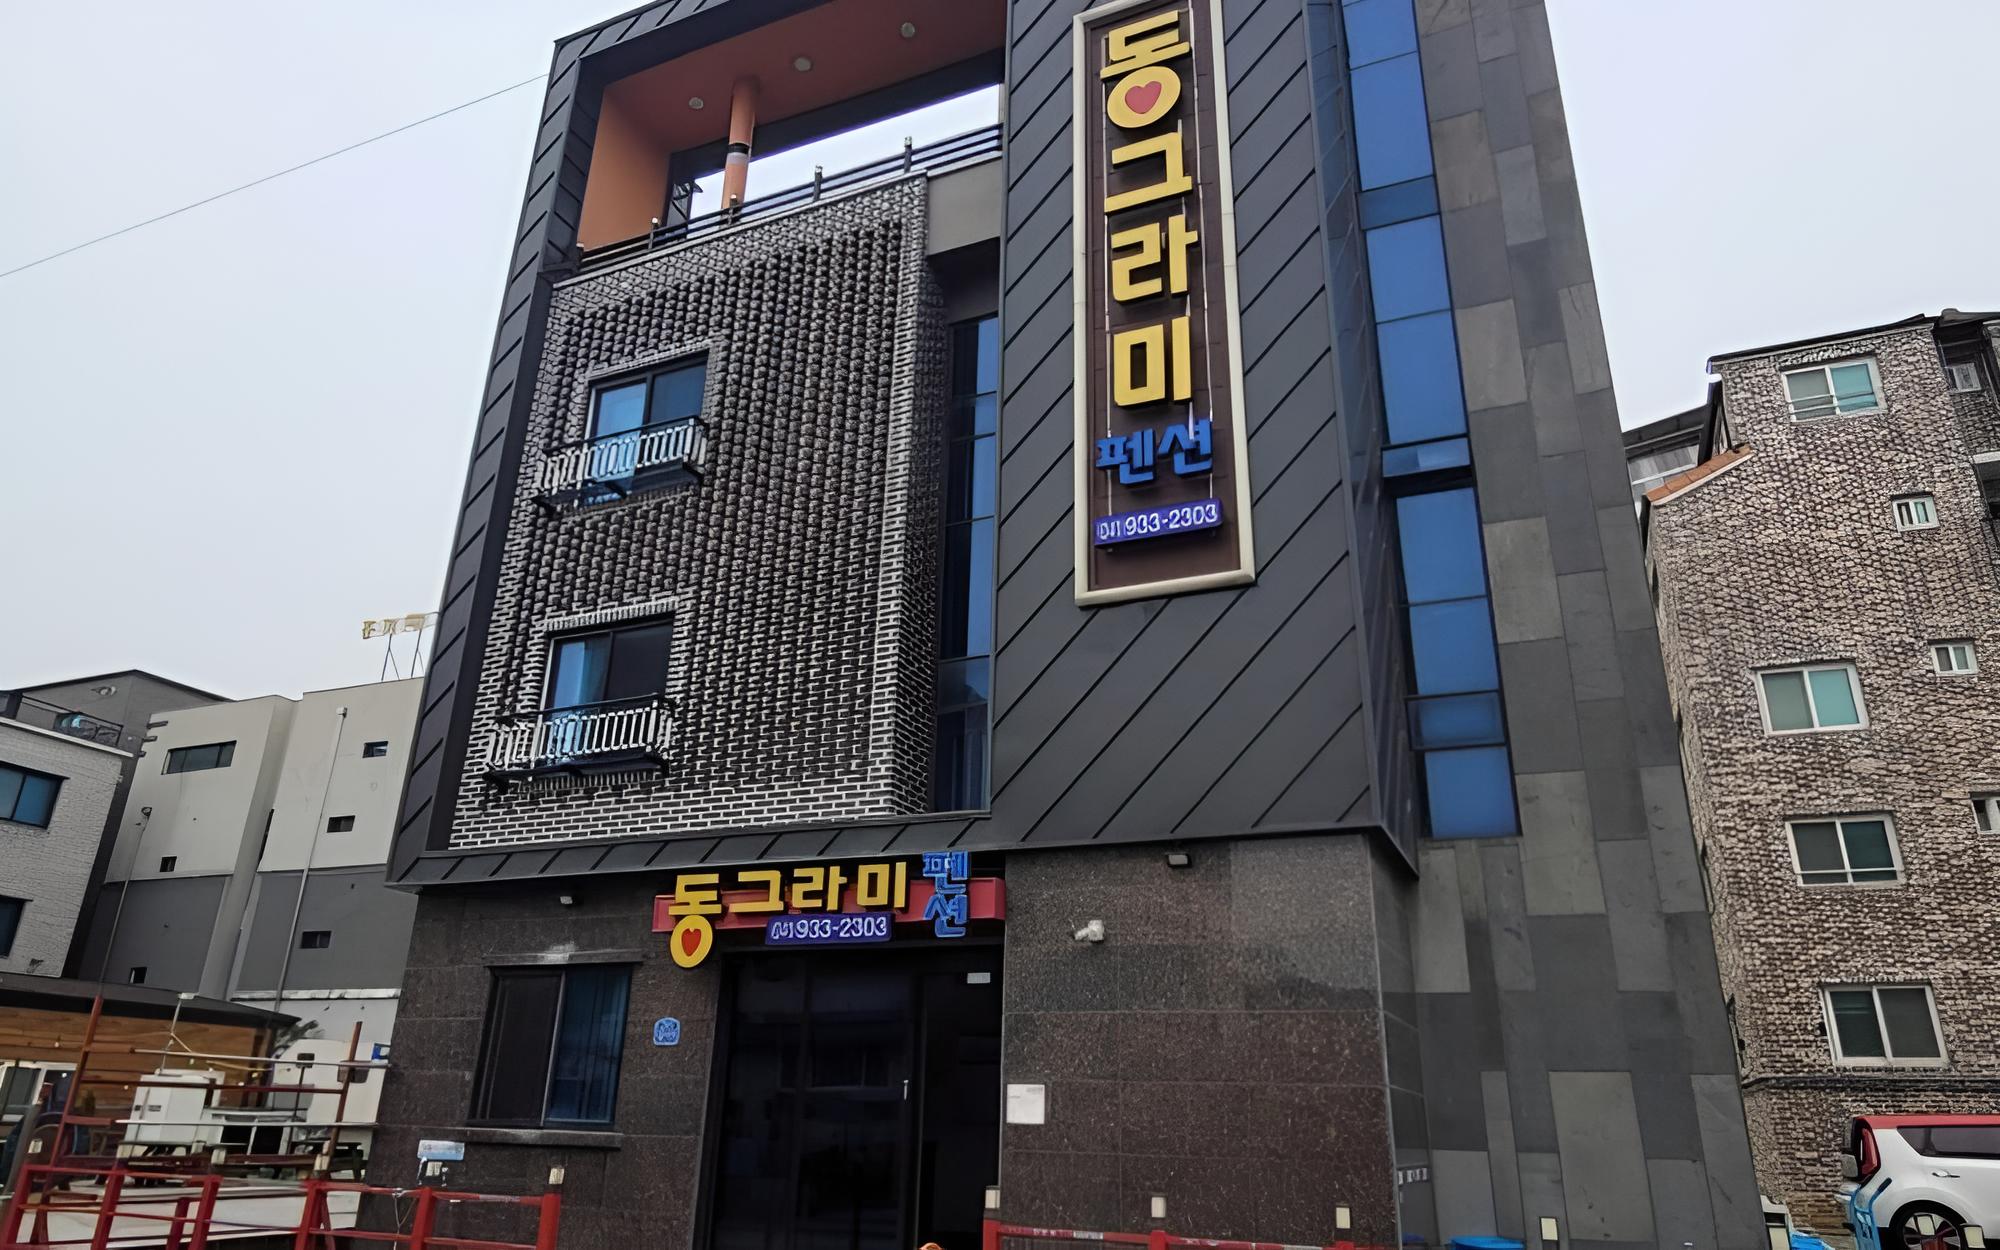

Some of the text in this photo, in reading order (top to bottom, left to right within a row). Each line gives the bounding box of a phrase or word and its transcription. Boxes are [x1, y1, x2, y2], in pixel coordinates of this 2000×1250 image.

[1100, 9, 1199, 407] 동그라미
[1095, 418, 1213, 485] 펜션
[668, 861, 908, 969] 동그라미
[922, 850, 968, 938] 펜션
